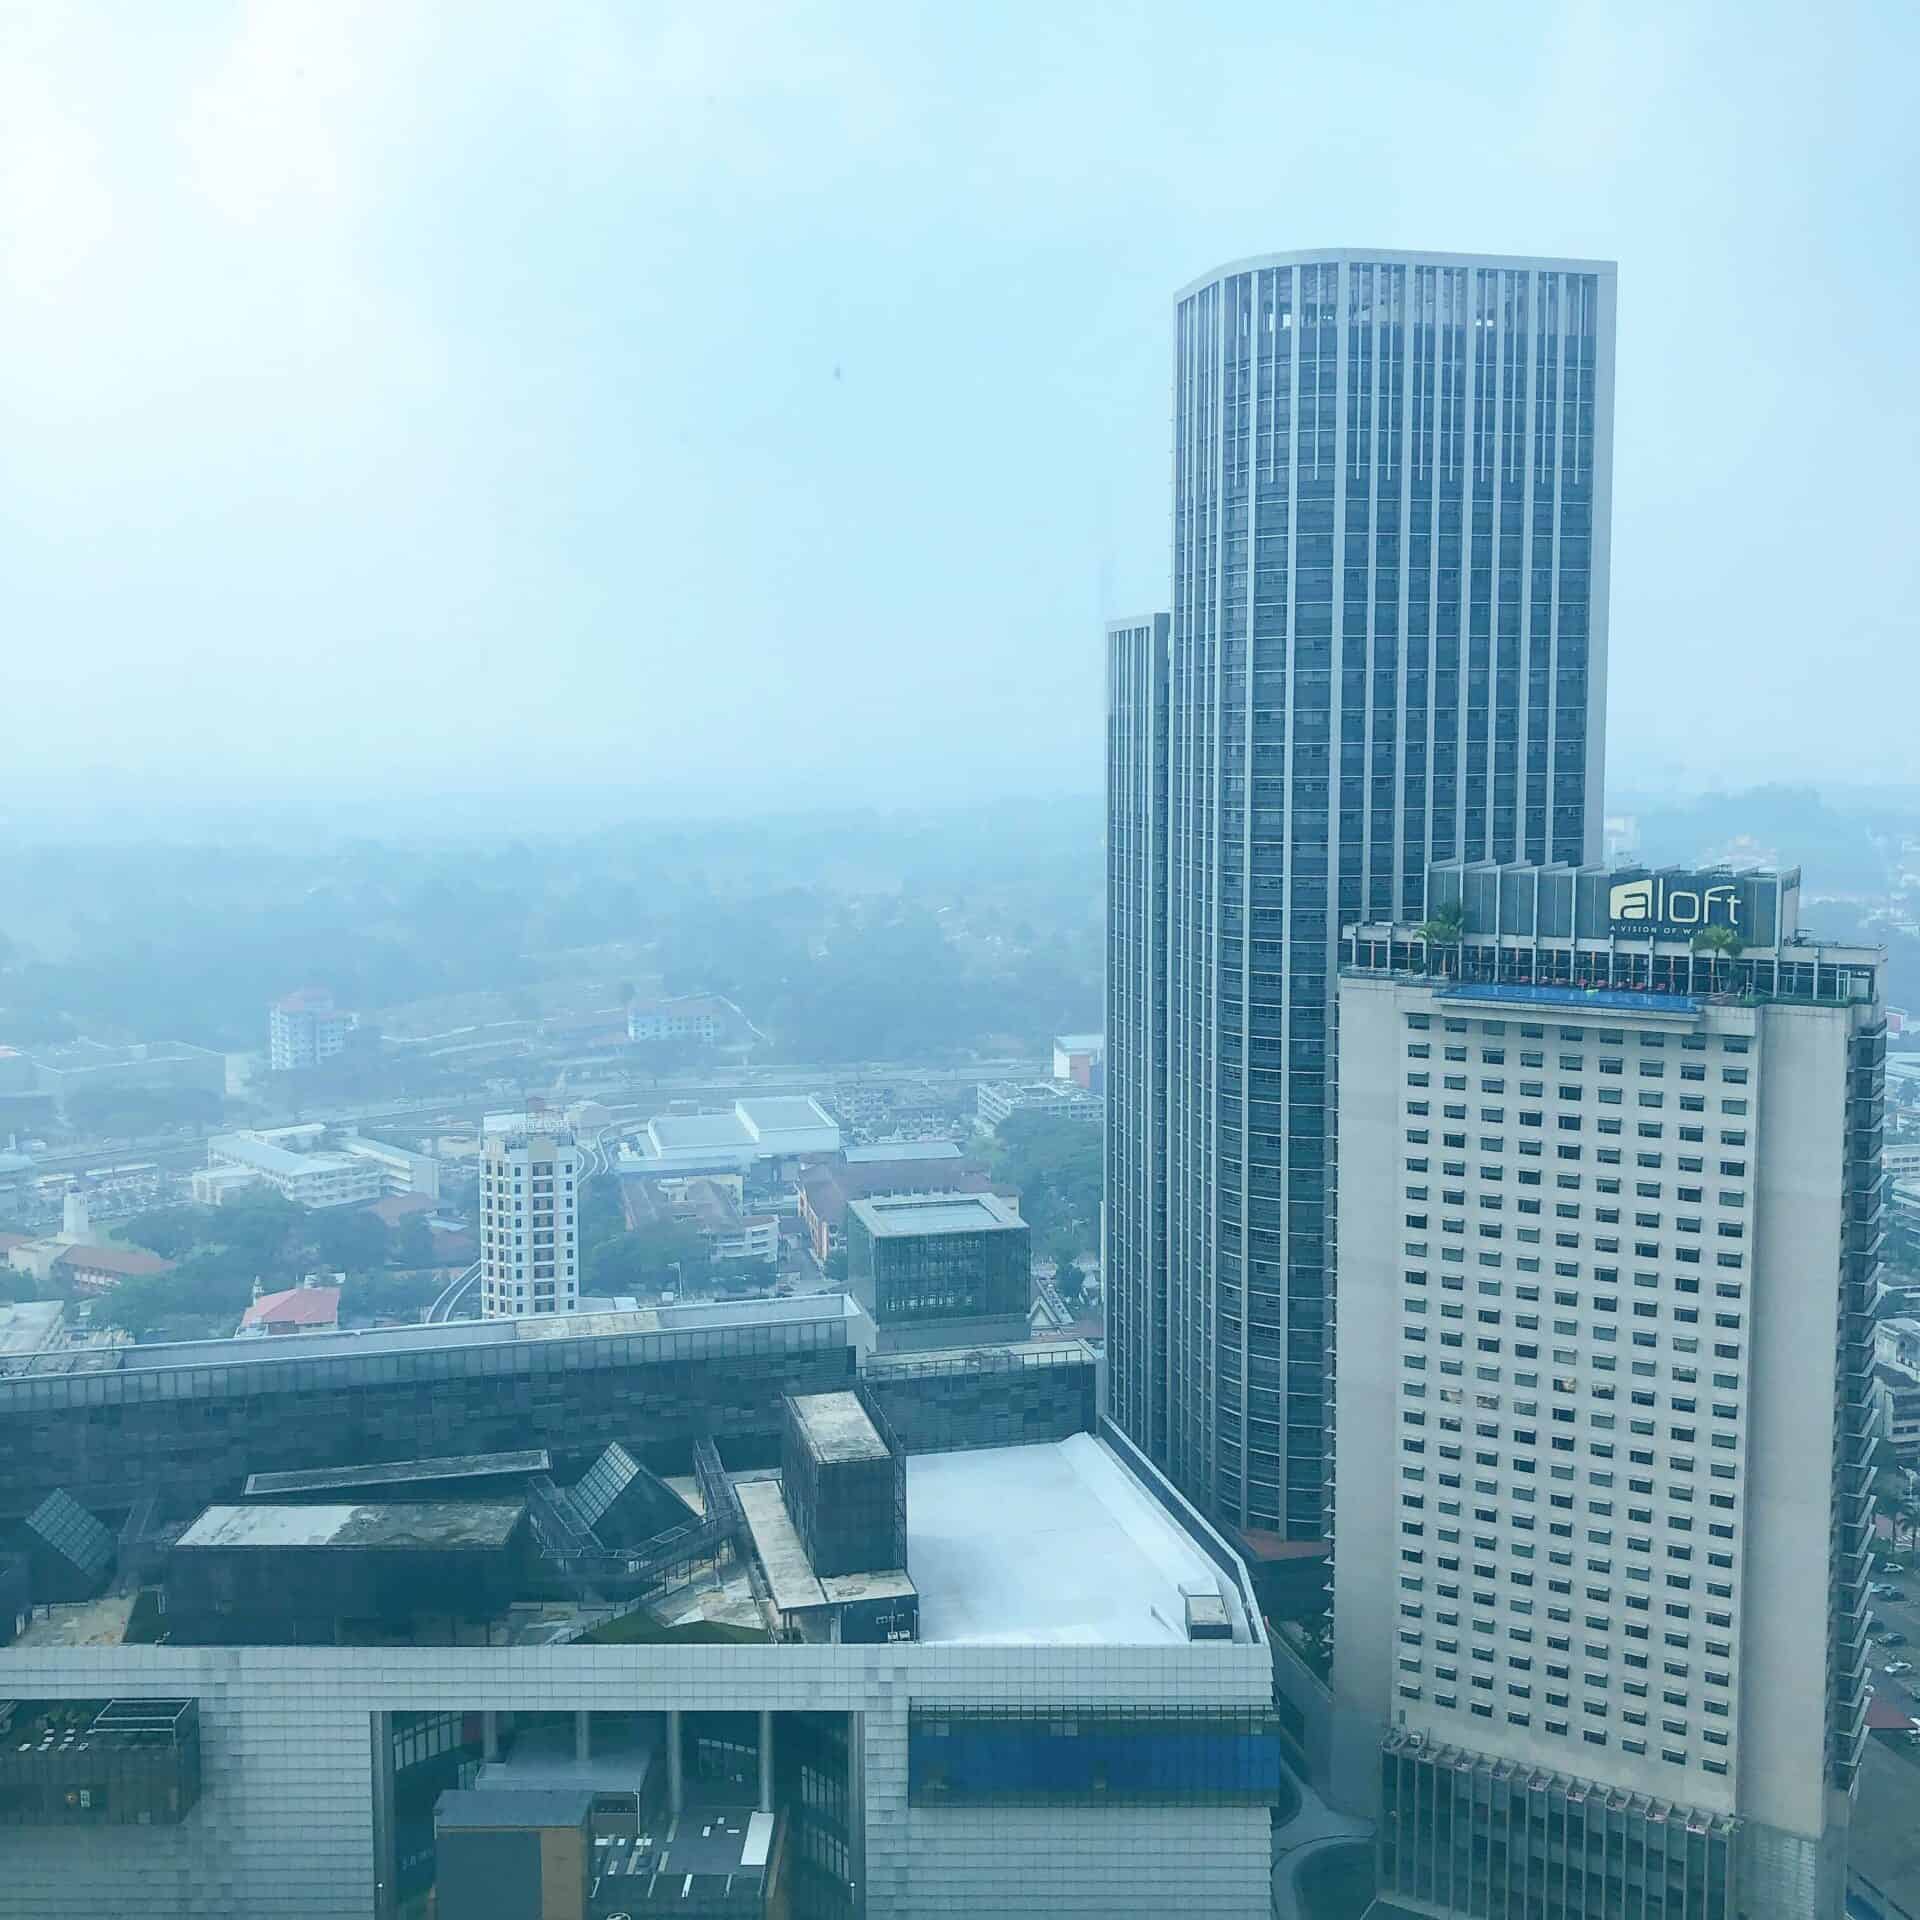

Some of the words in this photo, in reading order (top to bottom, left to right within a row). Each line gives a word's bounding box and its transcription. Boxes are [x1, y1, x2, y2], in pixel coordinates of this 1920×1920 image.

[1609, 878, 1742, 925] aloft
[1620, 926, 1657, 934] VISION
[1663, 927, 1678, 935] OF
